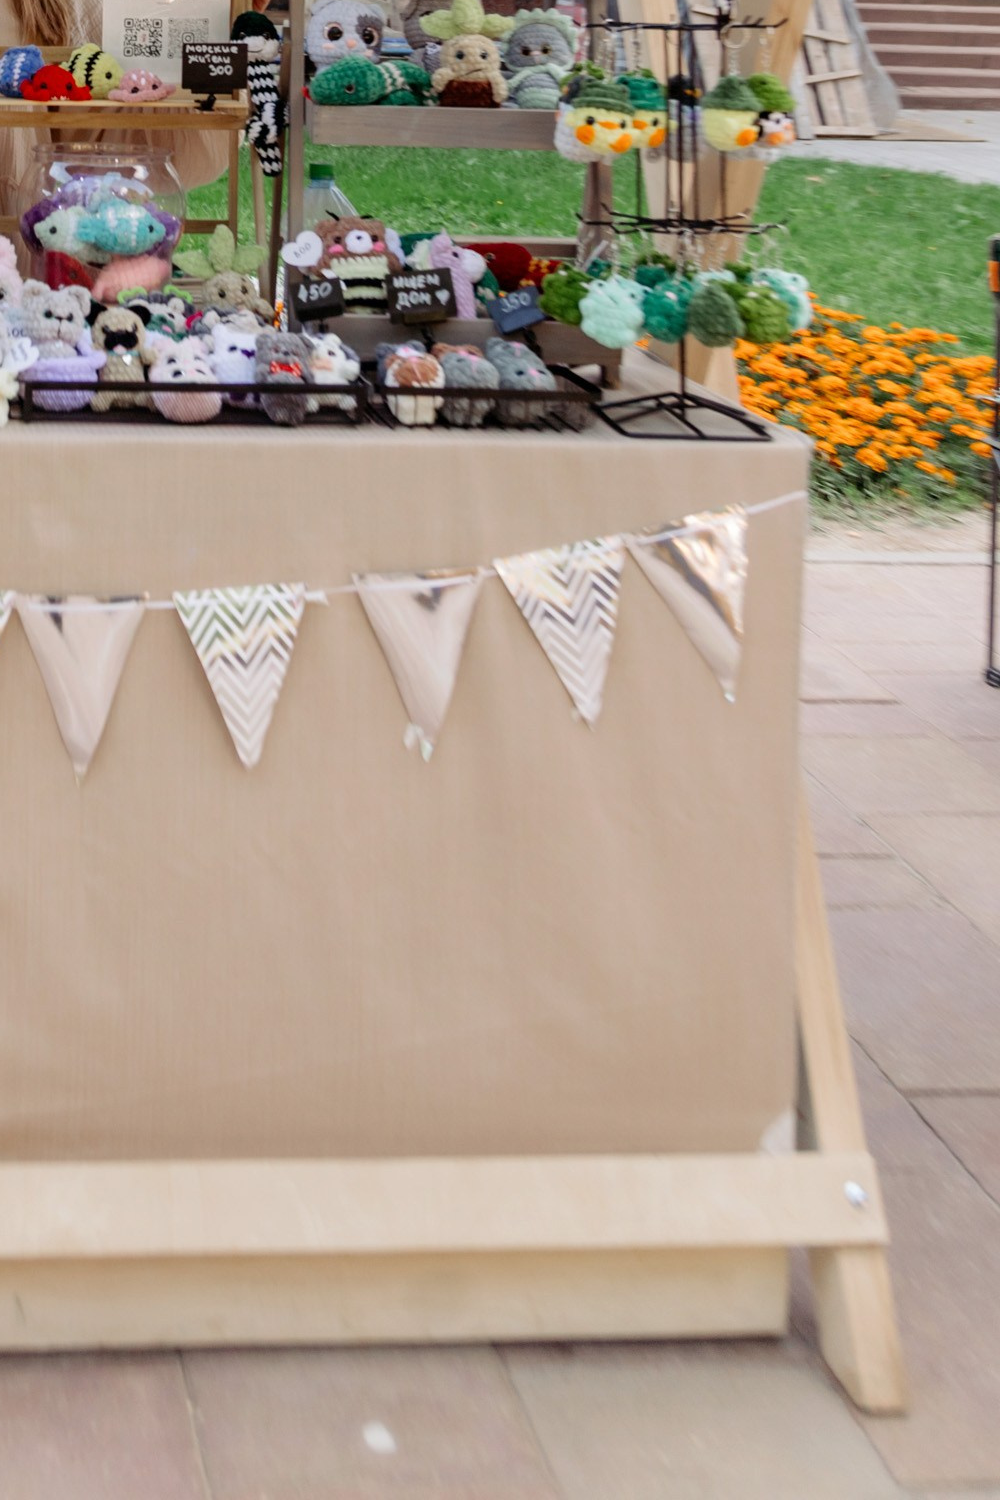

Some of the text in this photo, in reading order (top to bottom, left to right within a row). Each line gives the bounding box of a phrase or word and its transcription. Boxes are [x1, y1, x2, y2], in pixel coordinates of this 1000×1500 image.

[208, 64, 233, 77] 300
[392, 273, 441, 290] ИЩЕМ
[395, 290, 432, 311] ДОМ
